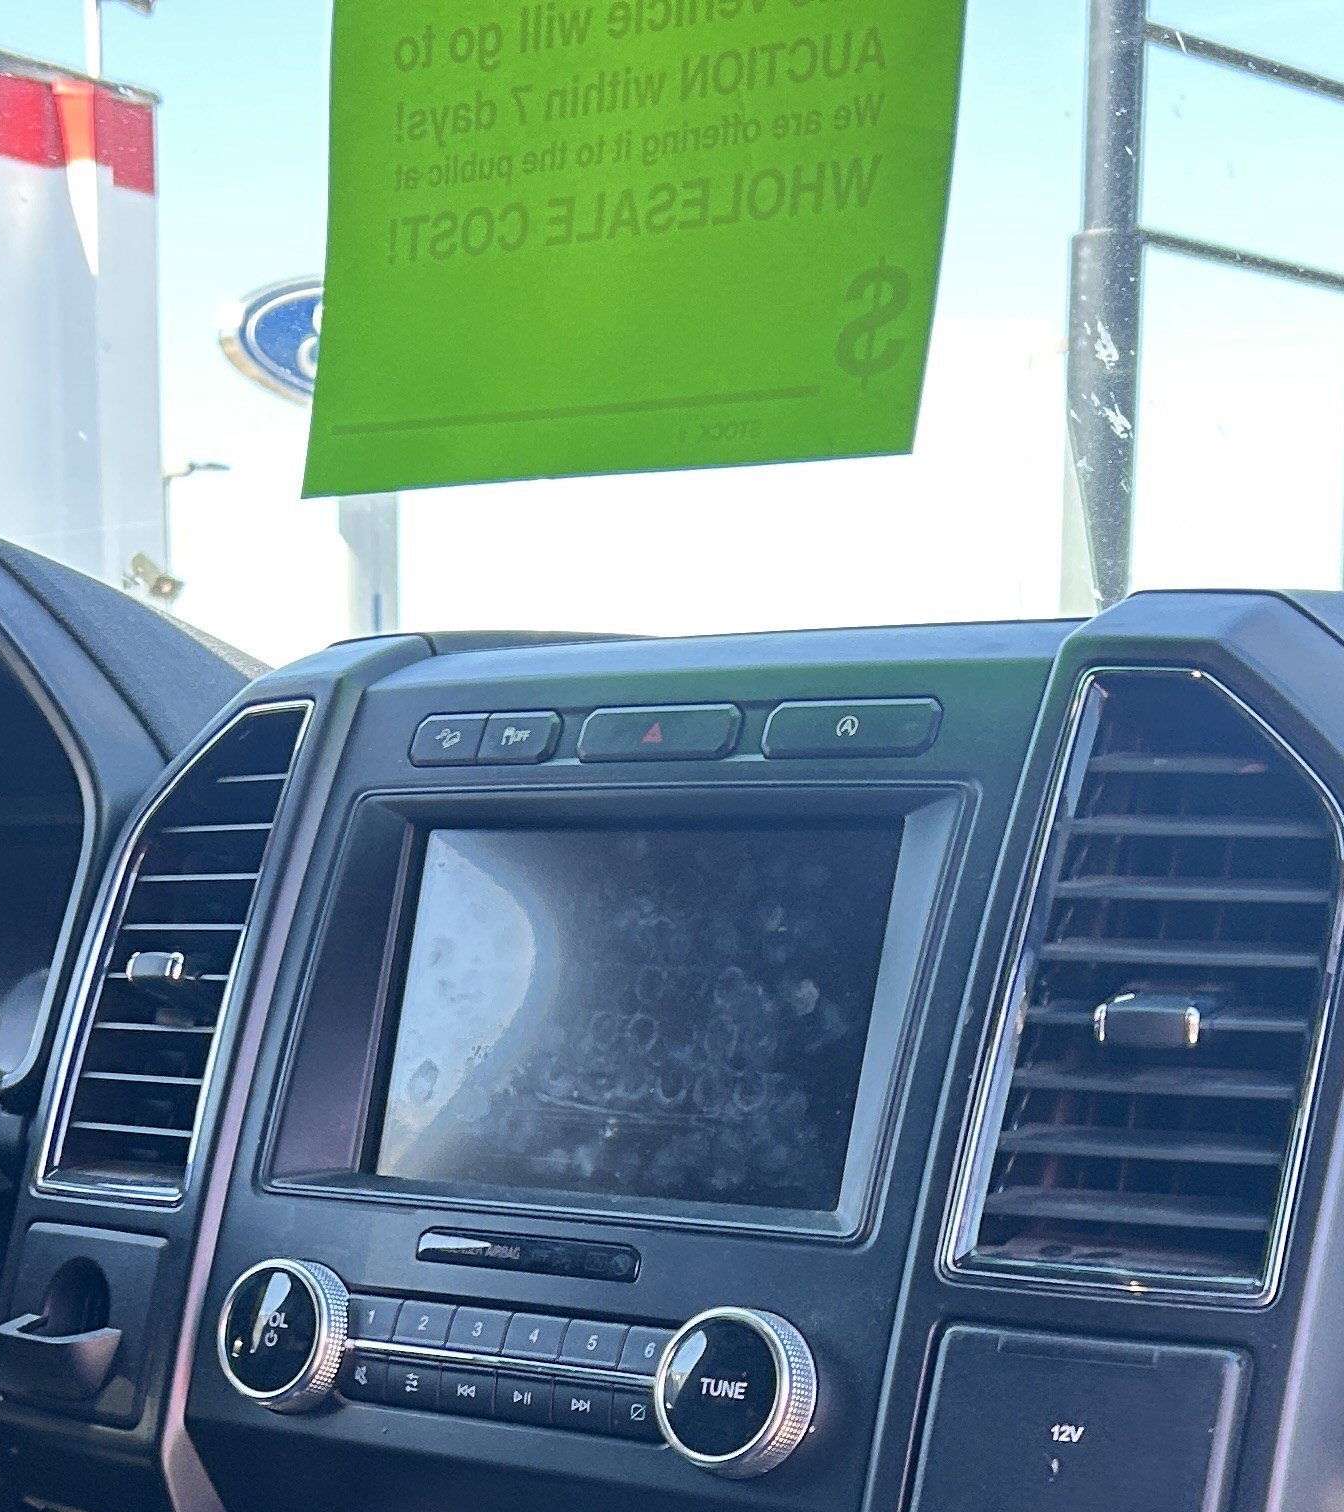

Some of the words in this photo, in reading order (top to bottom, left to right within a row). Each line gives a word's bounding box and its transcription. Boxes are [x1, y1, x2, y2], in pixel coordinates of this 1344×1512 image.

[261, 1310, 289, 1329] OL
[367, 1309, 377, 1325] 1
[417, 1314, 430, 1331] 2
[471, 1321, 484, 1338] 3
[528, 1328, 541, 1344] 4
[586, 1334, 599, 1351] 5
[643, 1341, 657, 1358] 6
[699, 1376, 749, 1401] TUNE
[1050, 1425, 1084, 1443] 12V
